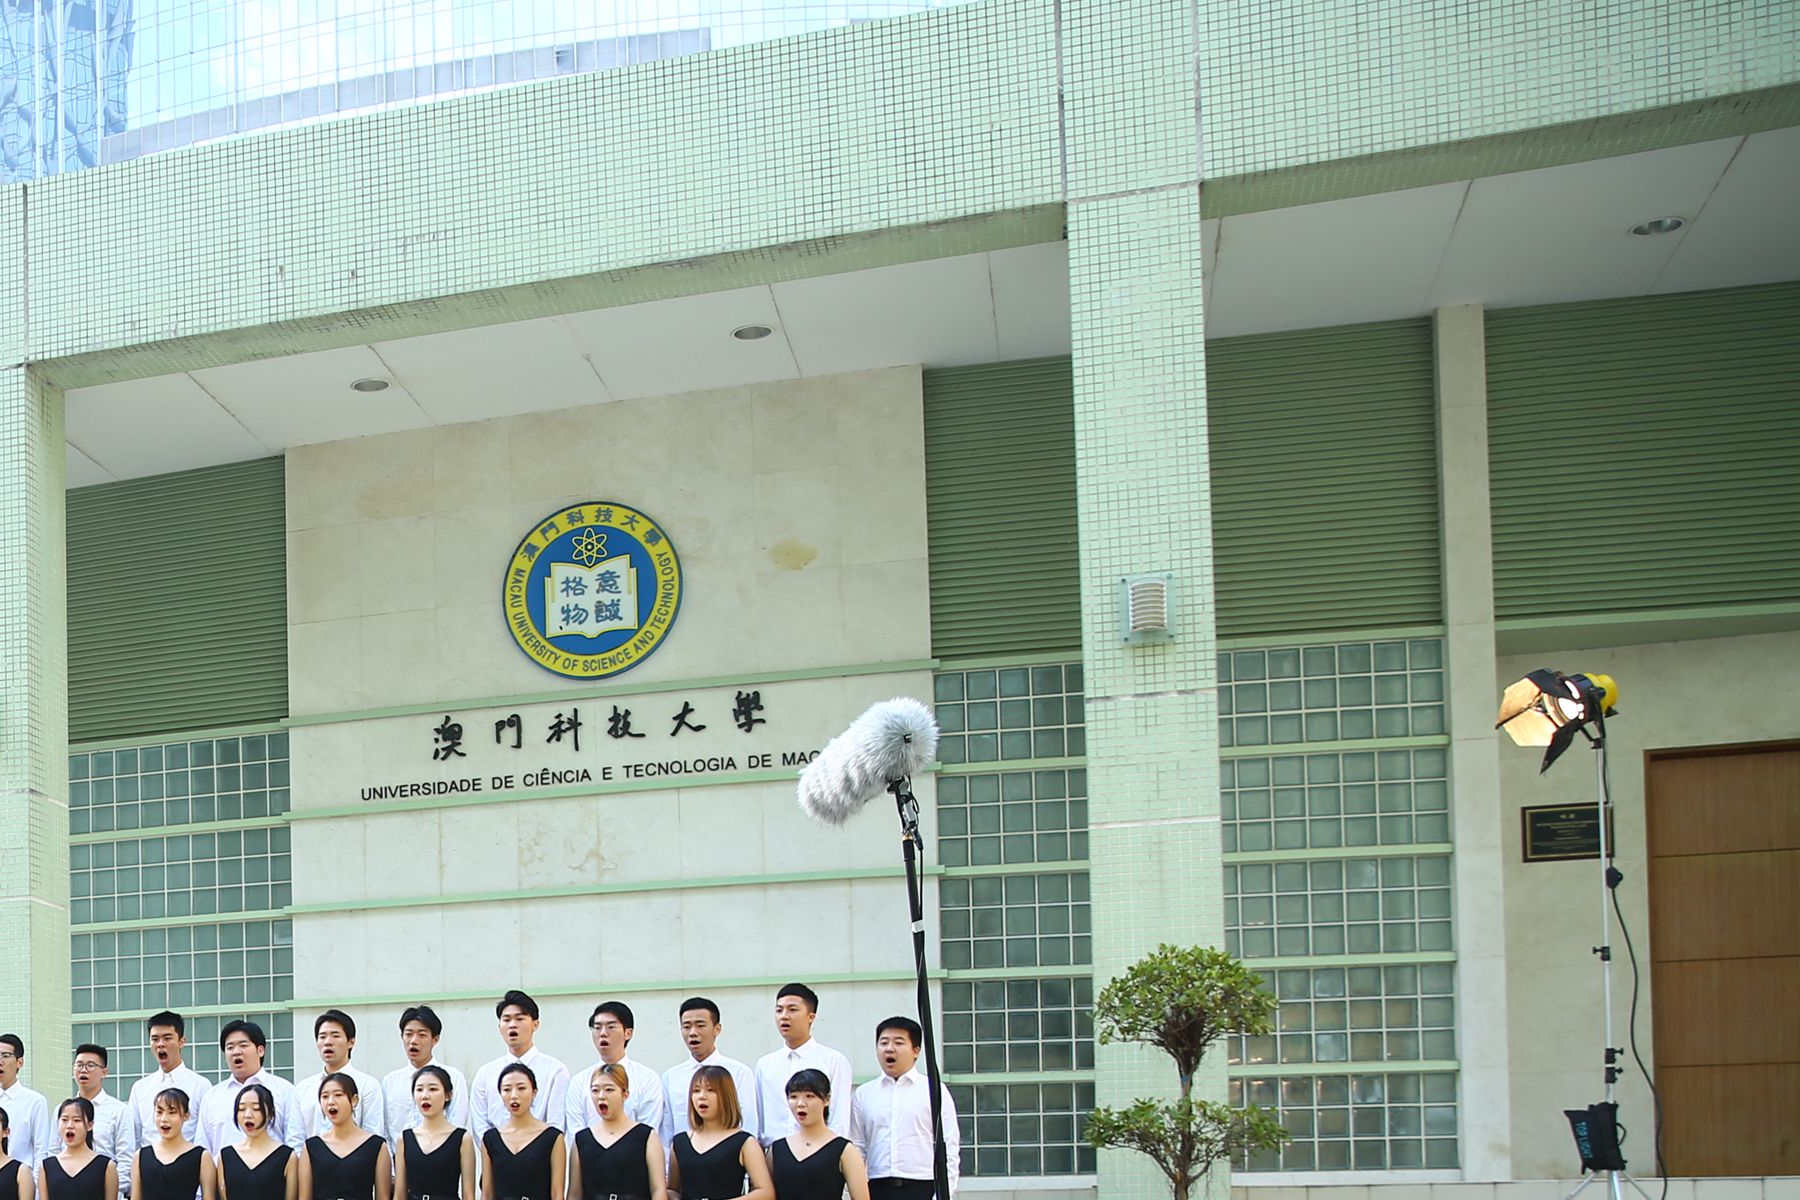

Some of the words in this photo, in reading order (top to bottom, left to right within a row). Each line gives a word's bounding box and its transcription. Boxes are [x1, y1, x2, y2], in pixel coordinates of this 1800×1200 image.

[509, 568, 526, 608] MACAU
[652, 551, 675, 630] TECHNOLOGY
[512, 612, 561, 665] UNIVERSITY
[582, 648, 633, 672] SCIENCE
[633, 631, 655, 654] AND
[562, 657, 579, 671] OF
[432, 690, 767, 761] 澳門科技大學
[361, 778, 482, 801] UNIVERSIDADE
[491, 775, 515, 790] DE
[523, 768, 592, 787] CIÊNCIA
[602, 767, 613, 780] E
[622, 757, 737, 779] TECNOLOGIA
[747, 753, 773, 768] DE
[782, 750, 820, 766] MAC
